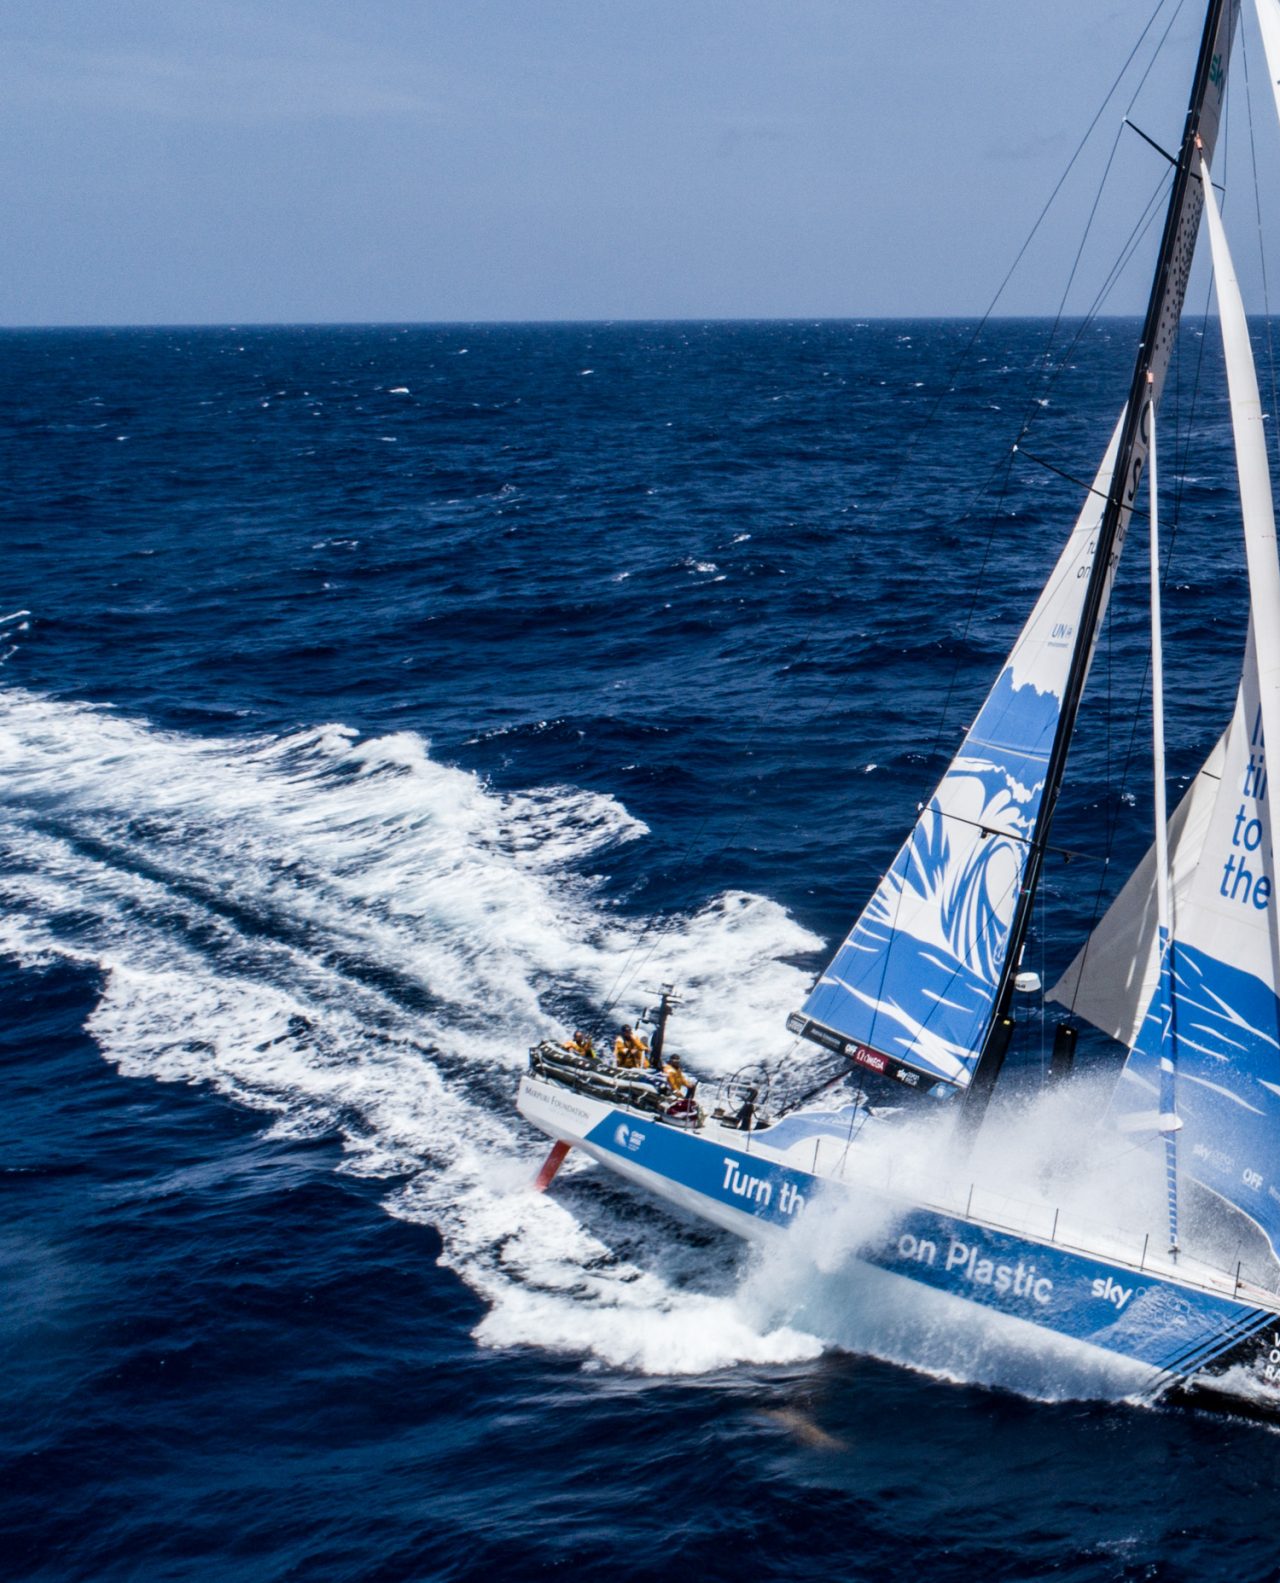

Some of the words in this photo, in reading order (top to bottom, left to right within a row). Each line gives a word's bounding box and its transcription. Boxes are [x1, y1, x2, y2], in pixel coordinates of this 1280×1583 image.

[1232, 804, 1263, 851] to
[1219, 854, 1272, 910] the
[864, 1053, 885, 1070] OMEGA
[1242, 1168, 1264, 1190] OFF
[722, 1157, 773, 1206] Turn
[779, 1183, 806, 1216] th
[898, 1233, 937, 1266] on
[945, 1243, 1054, 1304] Plastic
[1091, 1276, 1133, 1310] sky
